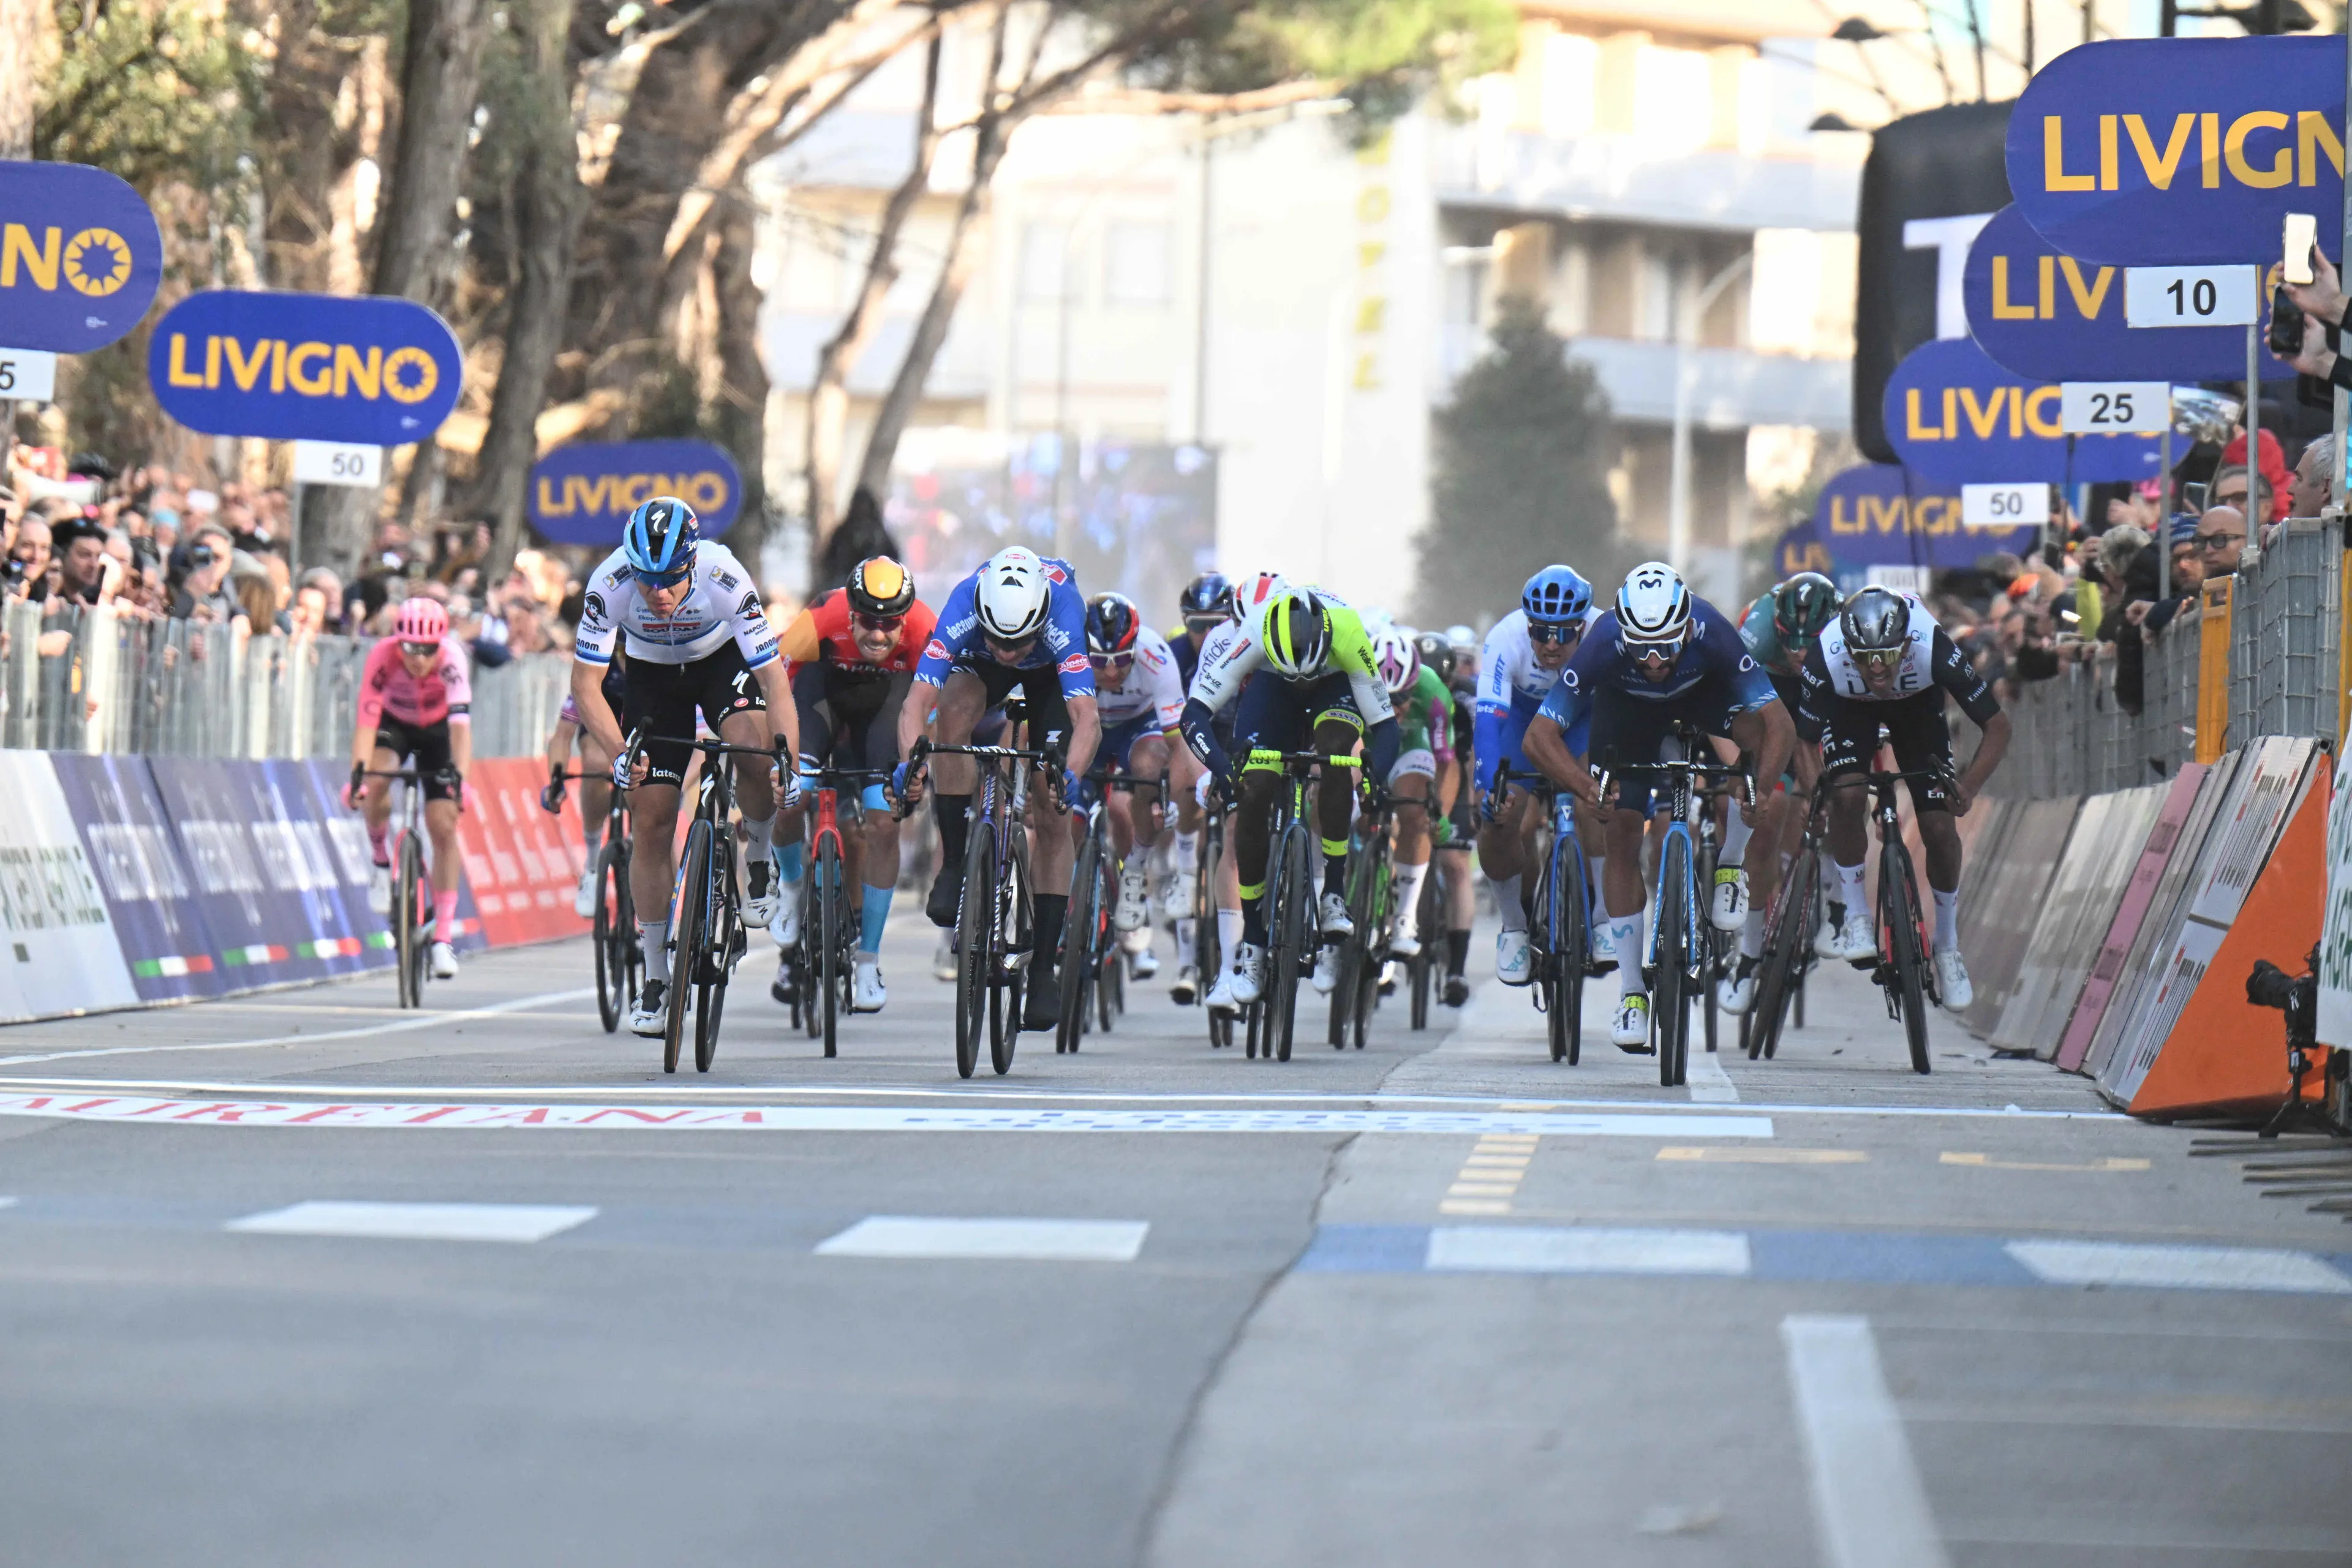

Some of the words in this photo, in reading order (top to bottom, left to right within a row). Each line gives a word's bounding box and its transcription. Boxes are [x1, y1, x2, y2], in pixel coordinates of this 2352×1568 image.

[2044, 110, 2344, 192] LIVIGN
[2166, 279, 2217, 316] 10
[169, 334, 438, 404] LIVIGNO
[2090, 393, 2134, 423] 25
[331, 453, 363, 477] 50
[1989, 493, 2023, 516] 50
[1492, 653, 1506, 696] GIANT
[652, 767, 681, 783] latexco
[1294, 782, 1303, 818] CUBE
